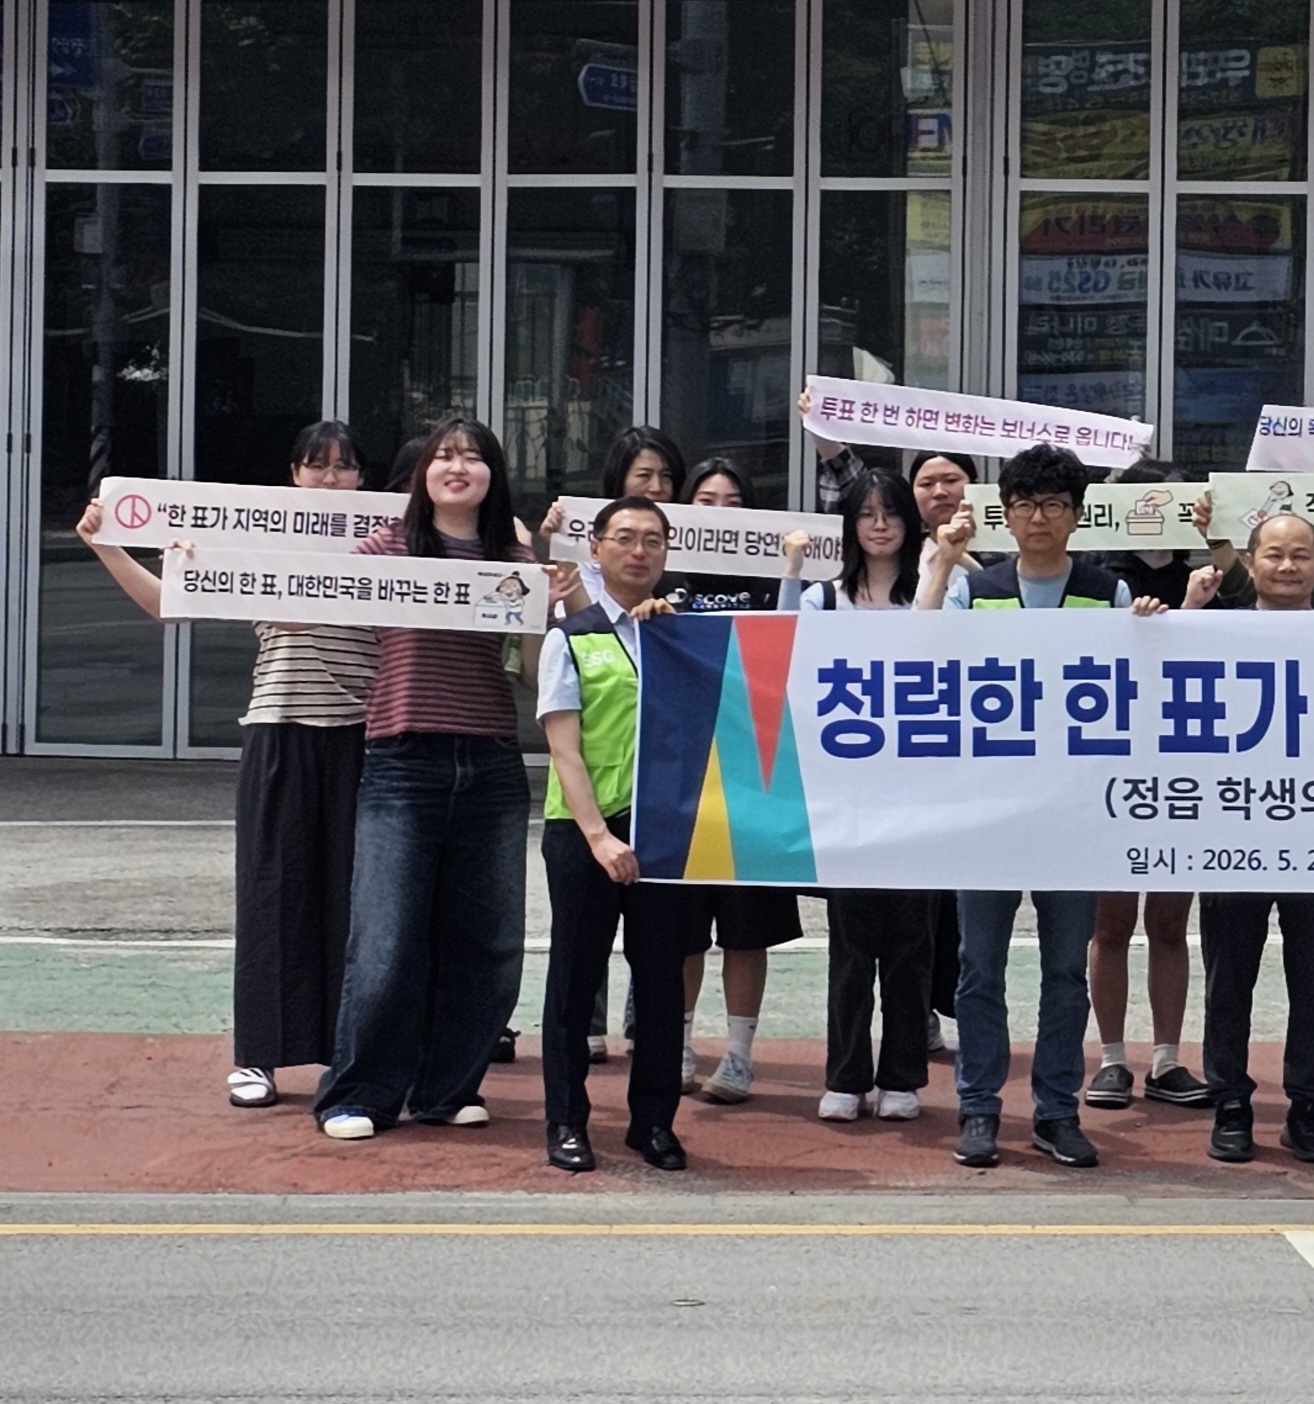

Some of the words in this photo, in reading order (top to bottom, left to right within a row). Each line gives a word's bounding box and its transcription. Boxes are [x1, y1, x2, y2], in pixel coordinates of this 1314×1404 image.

[820, 396, 856, 422] 투표
[859, 401, 878, 423] 한
[883, 404, 900, 425] 번
[905, 407, 939, 431] 하면
[944, 411, 996, 437] 변화는
[1000, 418, 1071, 445] 보너스로
[191, 506, 228, 531] 표가
[232, 508, 287, 535] 지역의
[293, 511, 348, 538] 미래를
[984, 504, 1009, 531] 투
[666, 526, 740, 556] 인이라면
[744, 530, 787, 557] 당연
[804, 535, 843, 561] 해야
[183, 569, 235, 595] 당신의
[239, 571, 258, 596] 한
[261, 572, 283, 600] 표,
[287, 575, 373, 602] 대한민국을
[377, 578, 429, 604] 바꾸는
[432, 580, 453, 605] 한
[455, 582, 471, 606] 표
[817, 657, 1043, 759] 청렴한
[1063, 656, 1138, 756] 한
[1158, 659, 1308, 758] 표가
[1104, 776, 1203, 820] (정읍
[1126, 847, 1177, 875] 일시
[1201, 849, 1268, 872] 2026.
[1277, 849, 1298, 872] 5.
